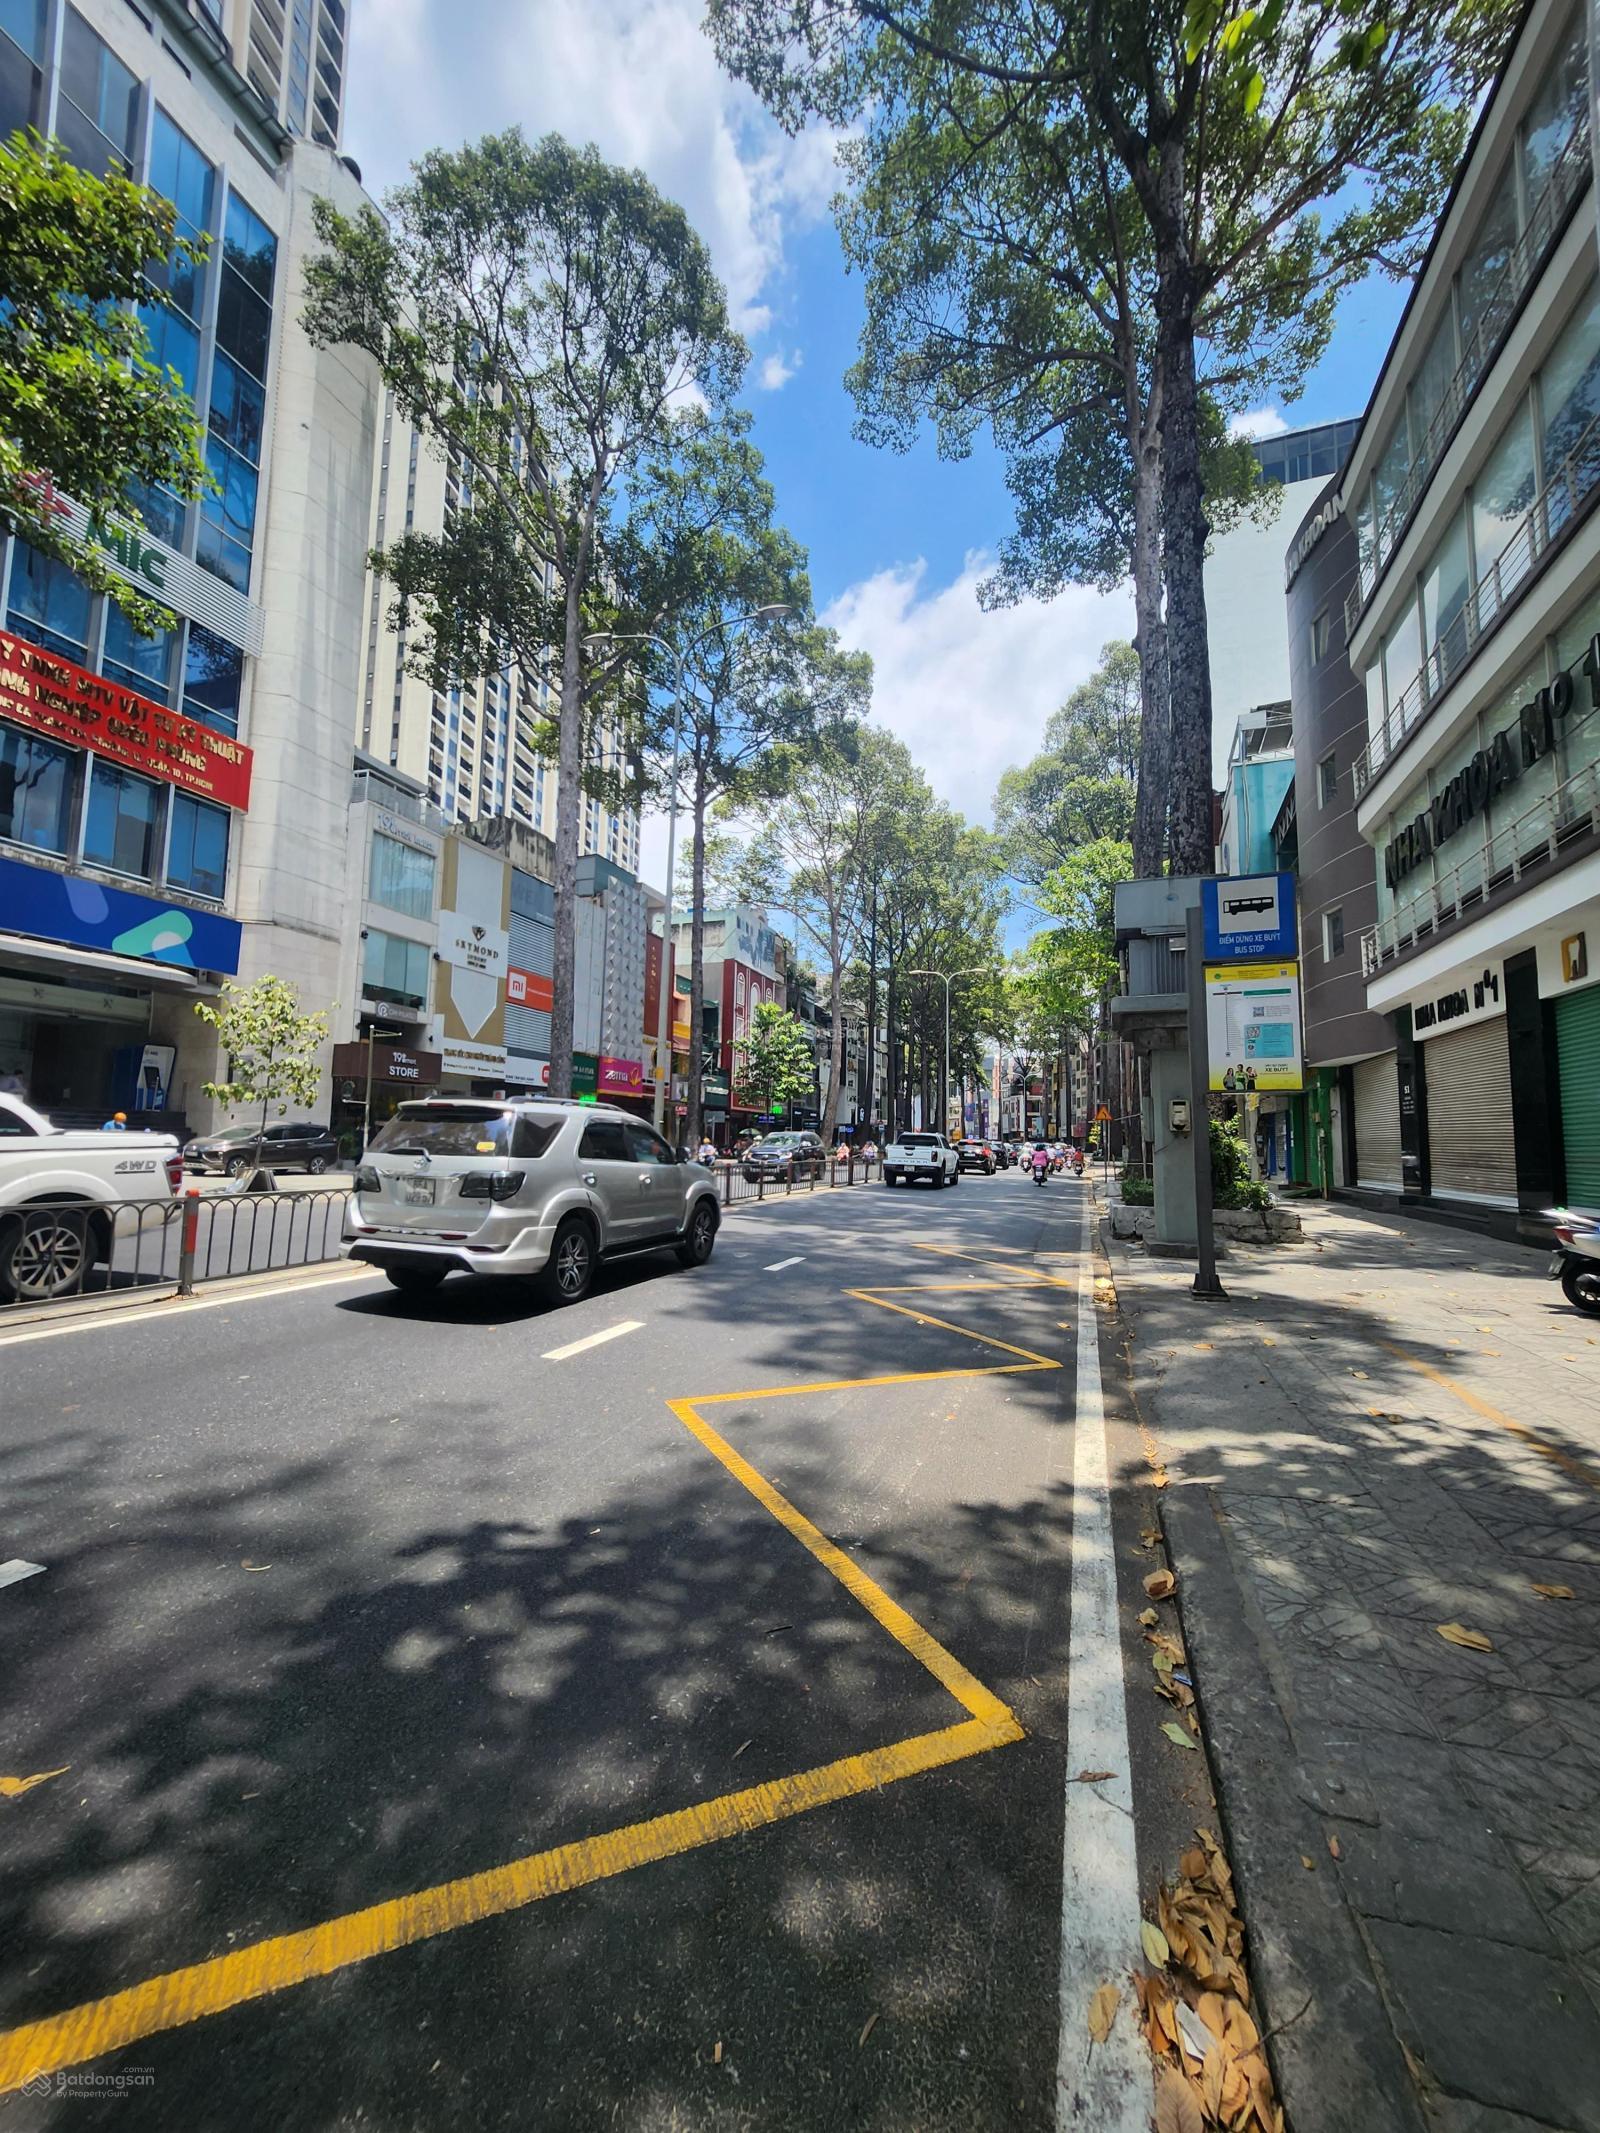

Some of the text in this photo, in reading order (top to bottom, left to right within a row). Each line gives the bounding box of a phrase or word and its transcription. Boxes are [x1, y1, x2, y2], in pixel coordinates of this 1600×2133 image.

[1254, 934, 1263, 942] XE
[1234, 944, 1265, 954] BUS STOP
[388, 1065, 419, 1079] STORE
[114, 1160, 157, 1171] 4WD
